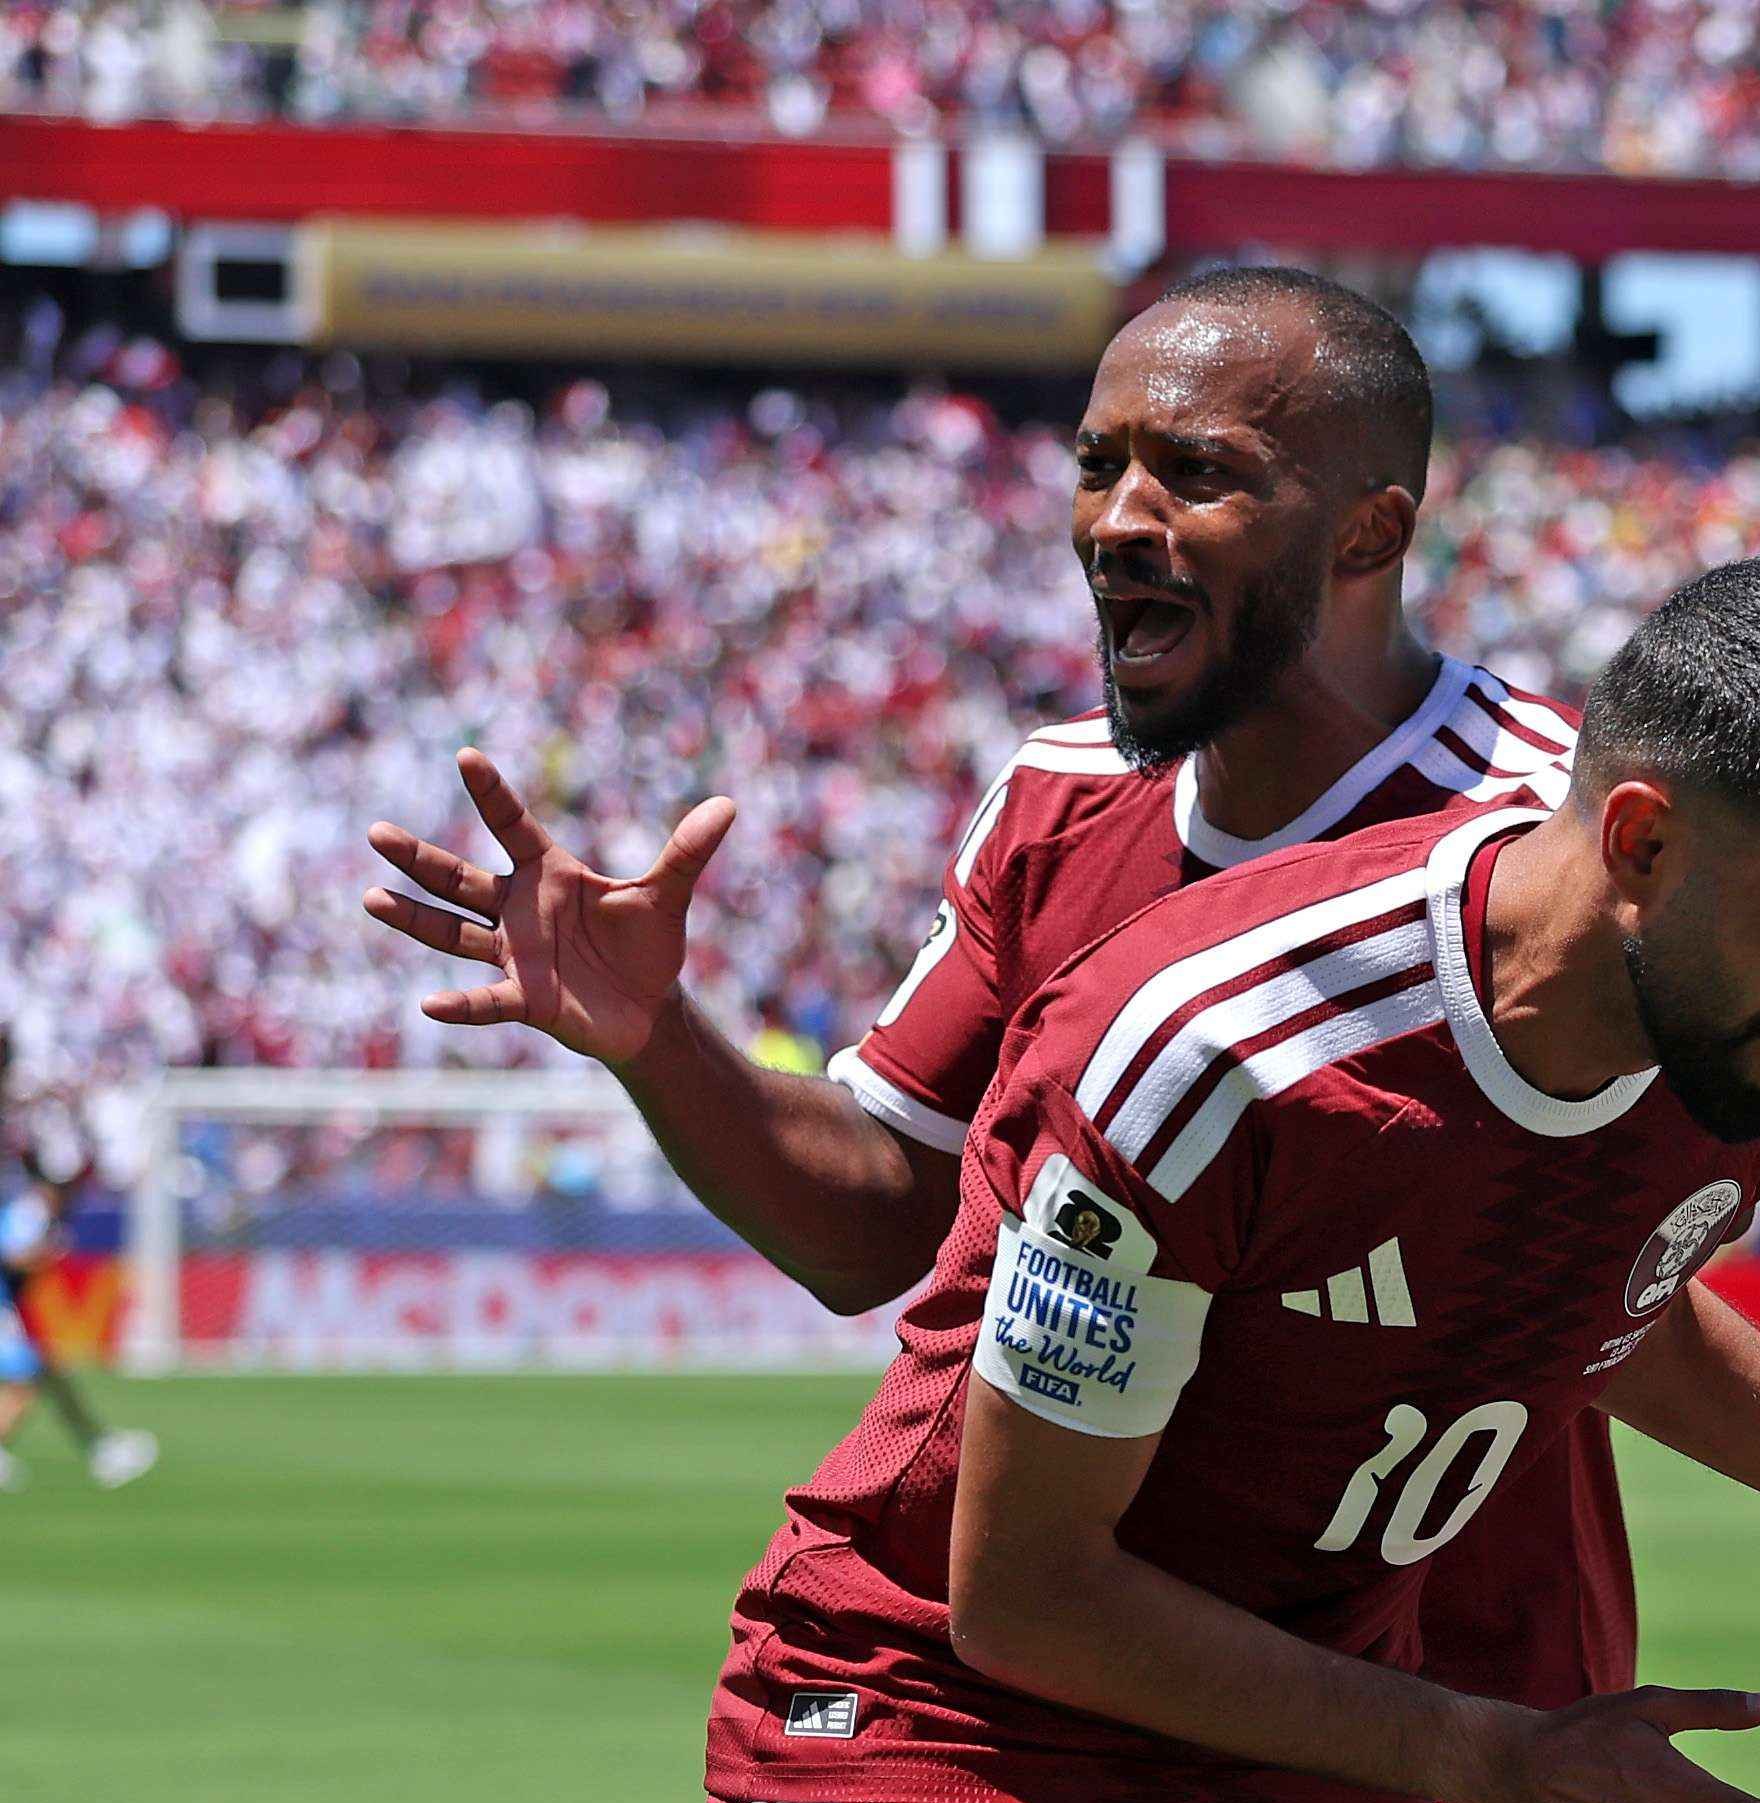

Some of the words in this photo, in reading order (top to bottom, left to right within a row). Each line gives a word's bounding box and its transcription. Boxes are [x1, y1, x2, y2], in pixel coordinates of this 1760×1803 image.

[1007, 1271, 1135, 1353] UNITES
[1016, 1240, 1138, 1313] FOOTBALL
[995, 1315, 1033, 1354] the
[1037, 1335, 1136, 1394] World
[1023, 1368, 1076, 1401] FIFA
[1314, 1401, 1528, 1565] 10
